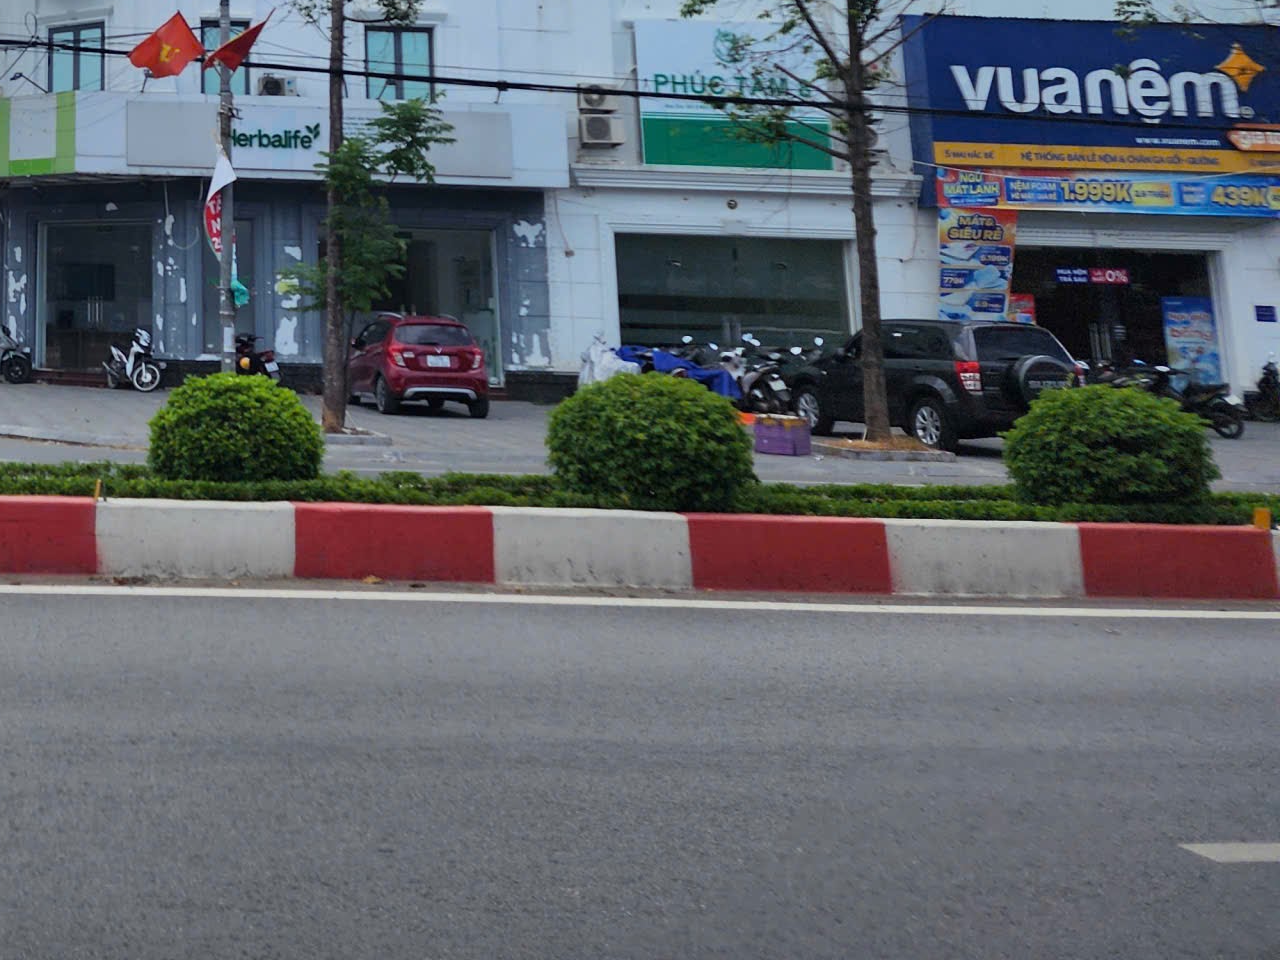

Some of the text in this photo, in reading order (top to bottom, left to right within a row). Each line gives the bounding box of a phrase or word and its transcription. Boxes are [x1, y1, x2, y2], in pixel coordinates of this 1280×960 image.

[654, 69, 725, 96] PHÚC
[1035, 150, 1065, 161] THỐNG
[1061, 181, 1133, 203] 1.999K
[1105, 269, 1129, 283] 0%
